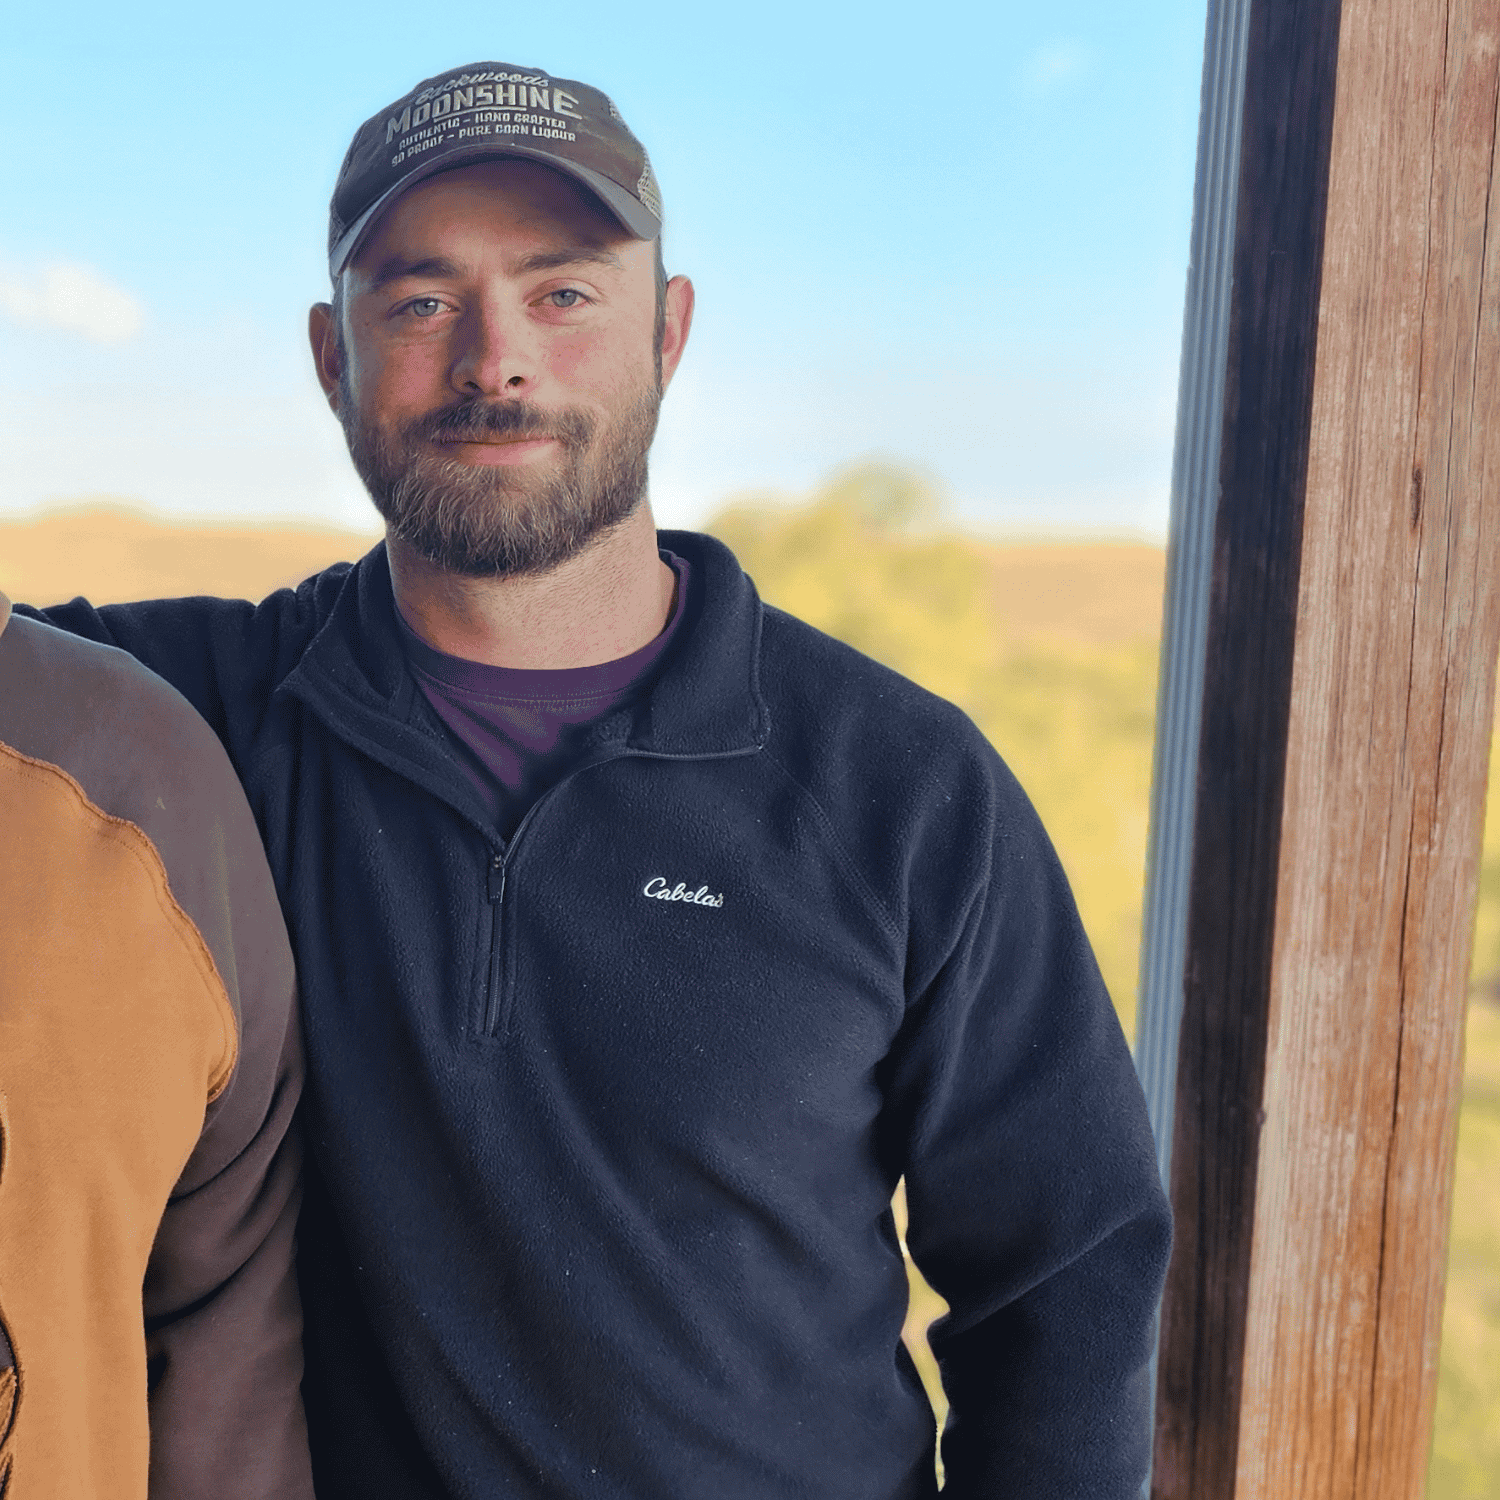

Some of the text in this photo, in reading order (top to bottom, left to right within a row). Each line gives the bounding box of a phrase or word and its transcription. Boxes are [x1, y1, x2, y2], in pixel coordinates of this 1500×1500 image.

[385, 83, 583, 145] MOONSHINE
[398, 117, 461, 151] AUTHENTIC
[474, 111, 511, 124] HAND
[407, 134, 445, 158] PROOF
[458, 124, 492, 139] PURE
[494, 124, 529, 135] CORN
